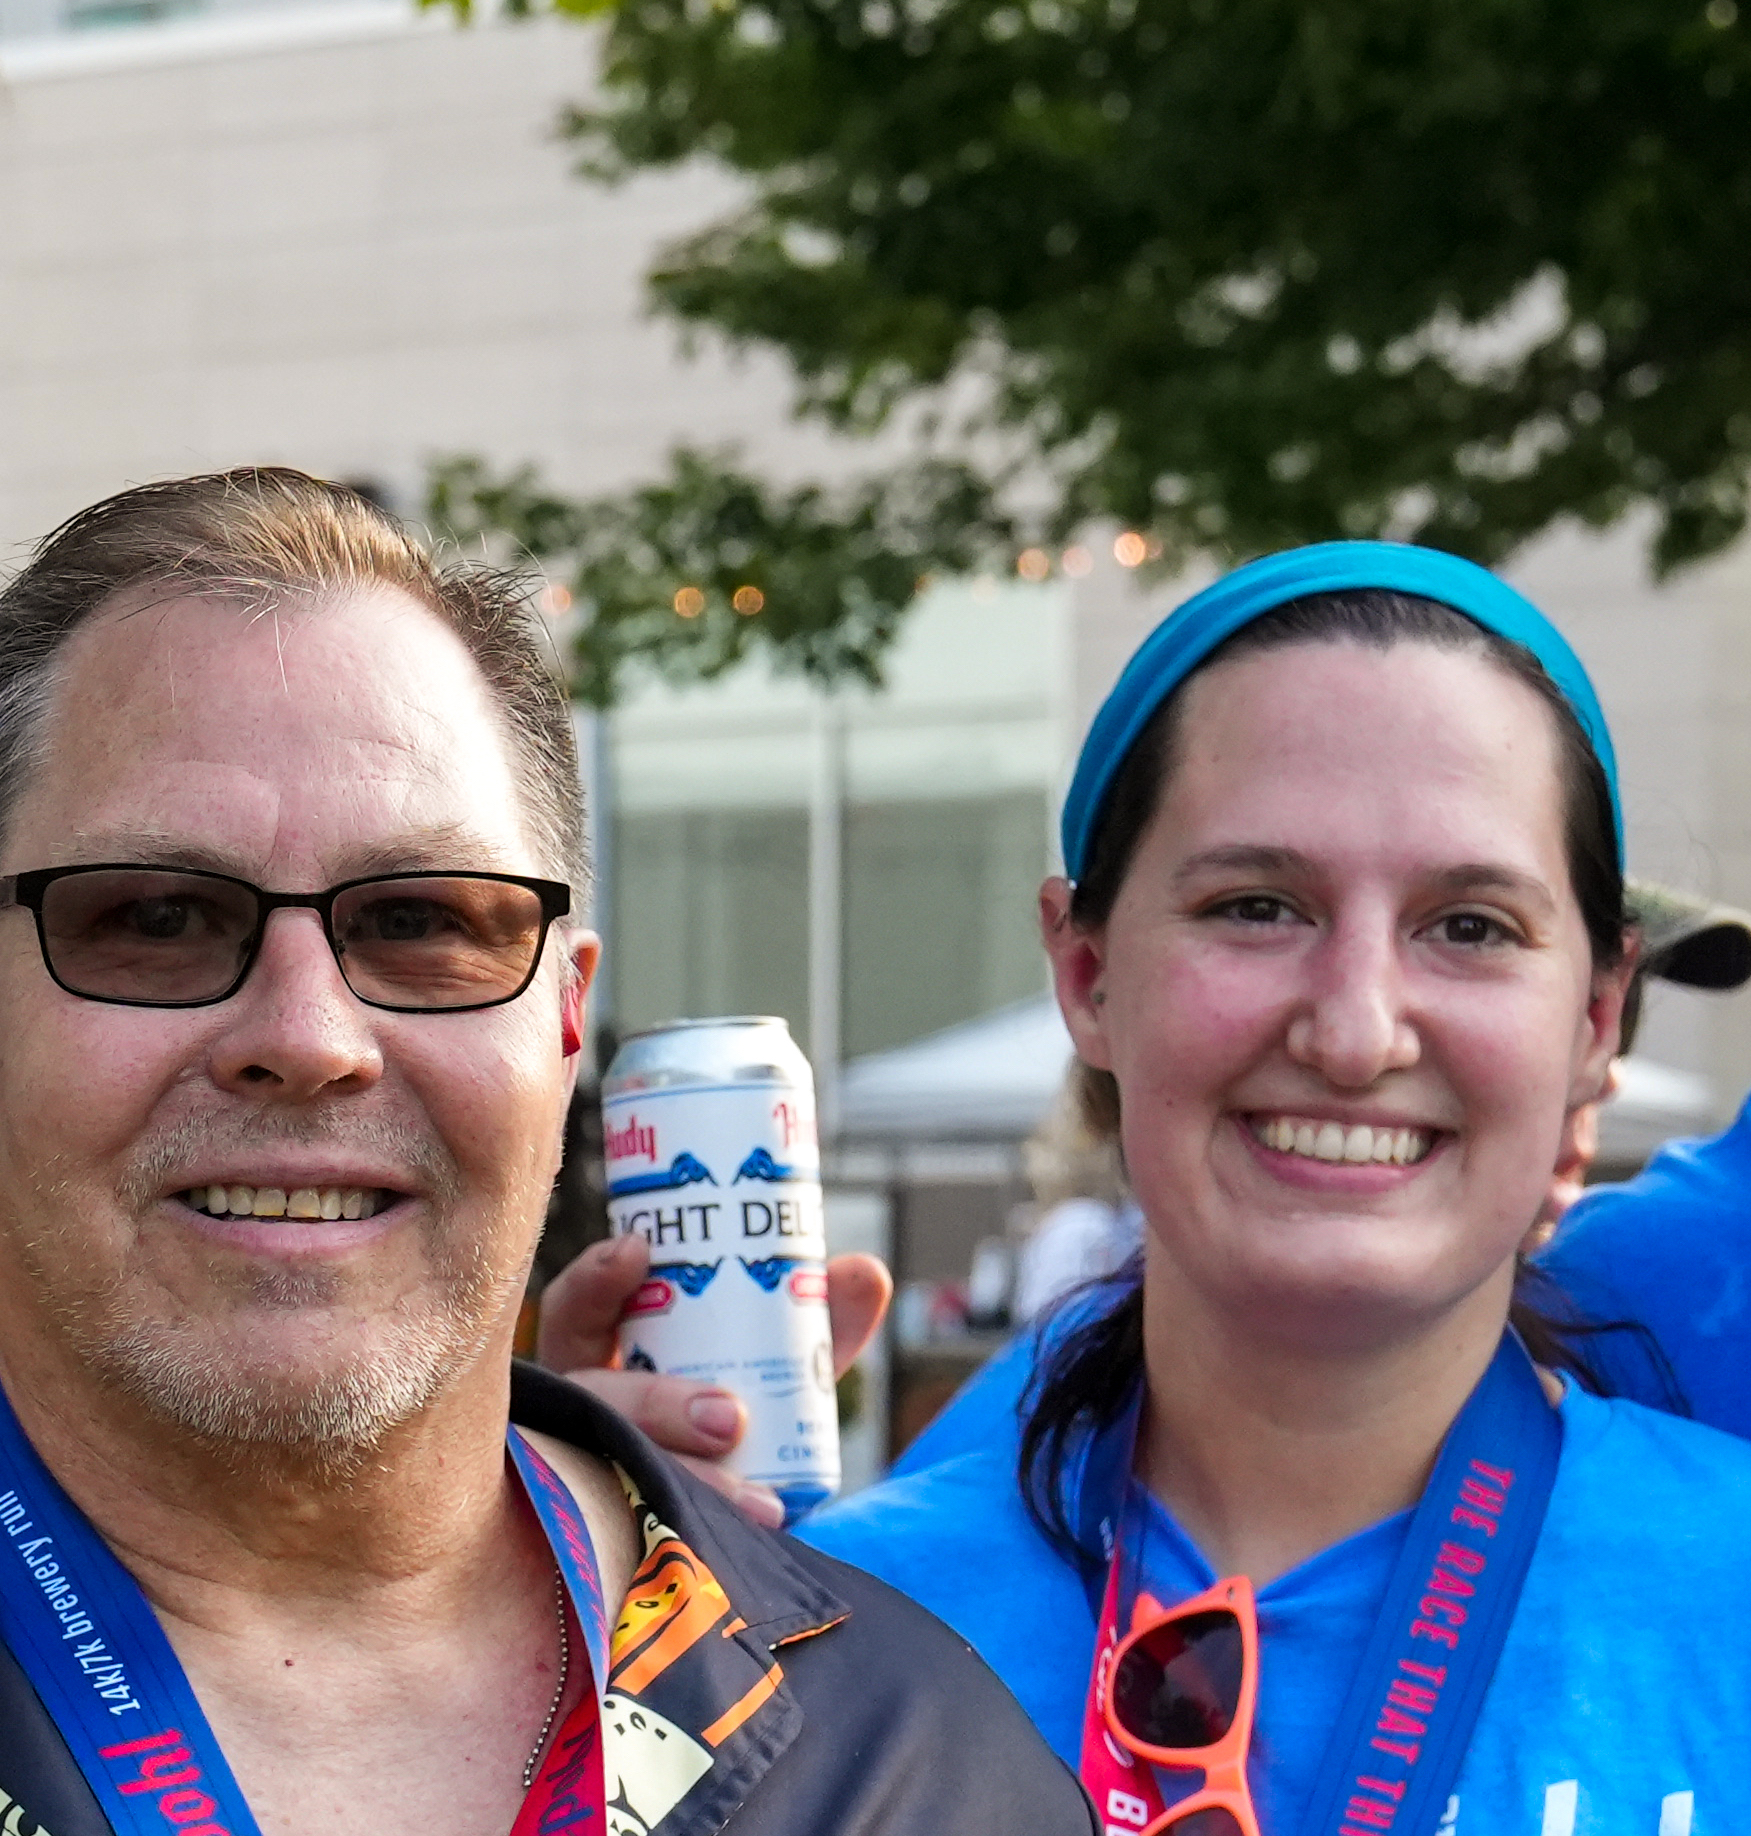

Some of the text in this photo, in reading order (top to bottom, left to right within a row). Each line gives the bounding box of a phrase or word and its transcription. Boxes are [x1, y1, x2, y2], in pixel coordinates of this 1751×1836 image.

[1451, 1458, 1516, 1540] THE
[18, 1536, 94, 1640] brewery
[1408, 1544, 1486, 1652] RACE
[74, 1638, 140, 1715] 14k/7k
[1362, 1658, 1447, 1765] THAT
